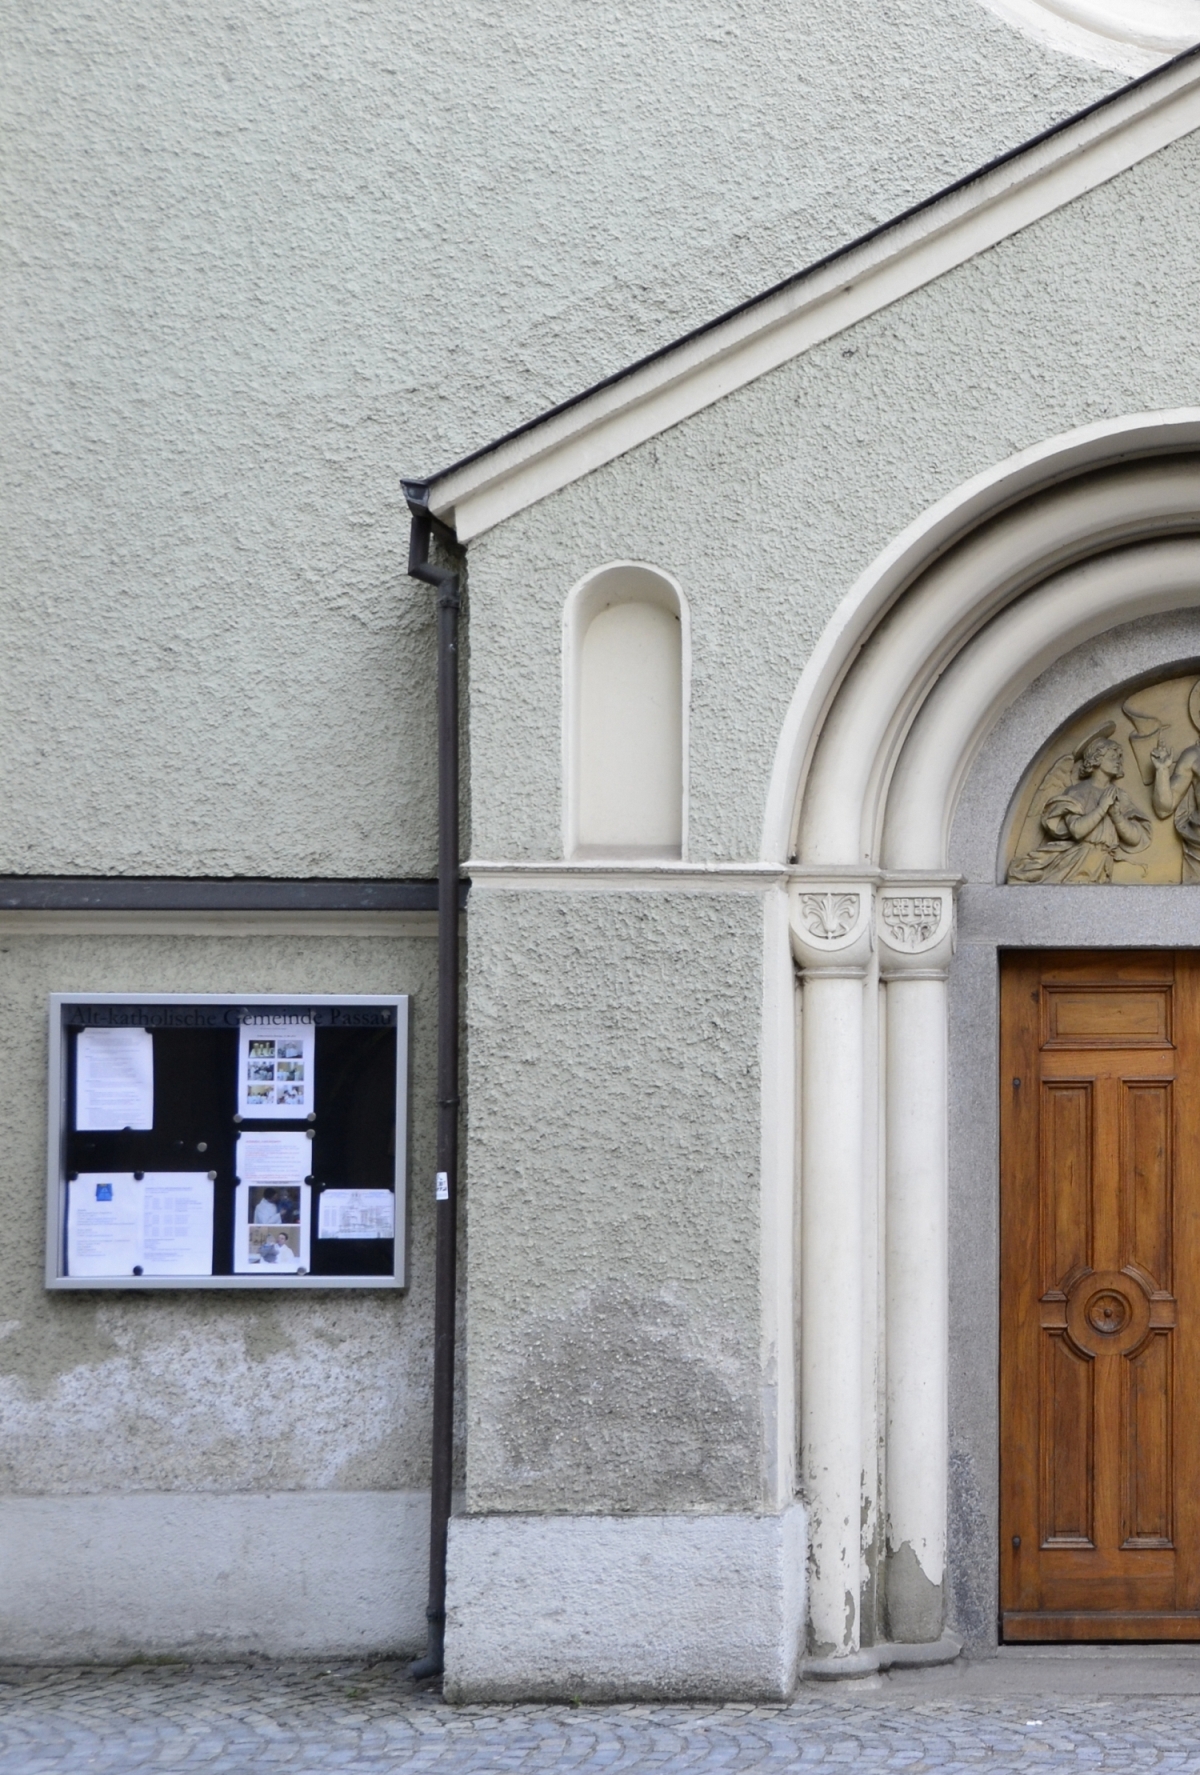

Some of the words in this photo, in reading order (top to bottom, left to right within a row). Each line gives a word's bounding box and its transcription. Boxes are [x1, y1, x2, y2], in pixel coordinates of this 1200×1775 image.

[70, 1005, 217, 1026] Alt-katholische
[223, 1006, 322, 1026] Gemeinde
[330, 1006, 392, 1025] Passau
